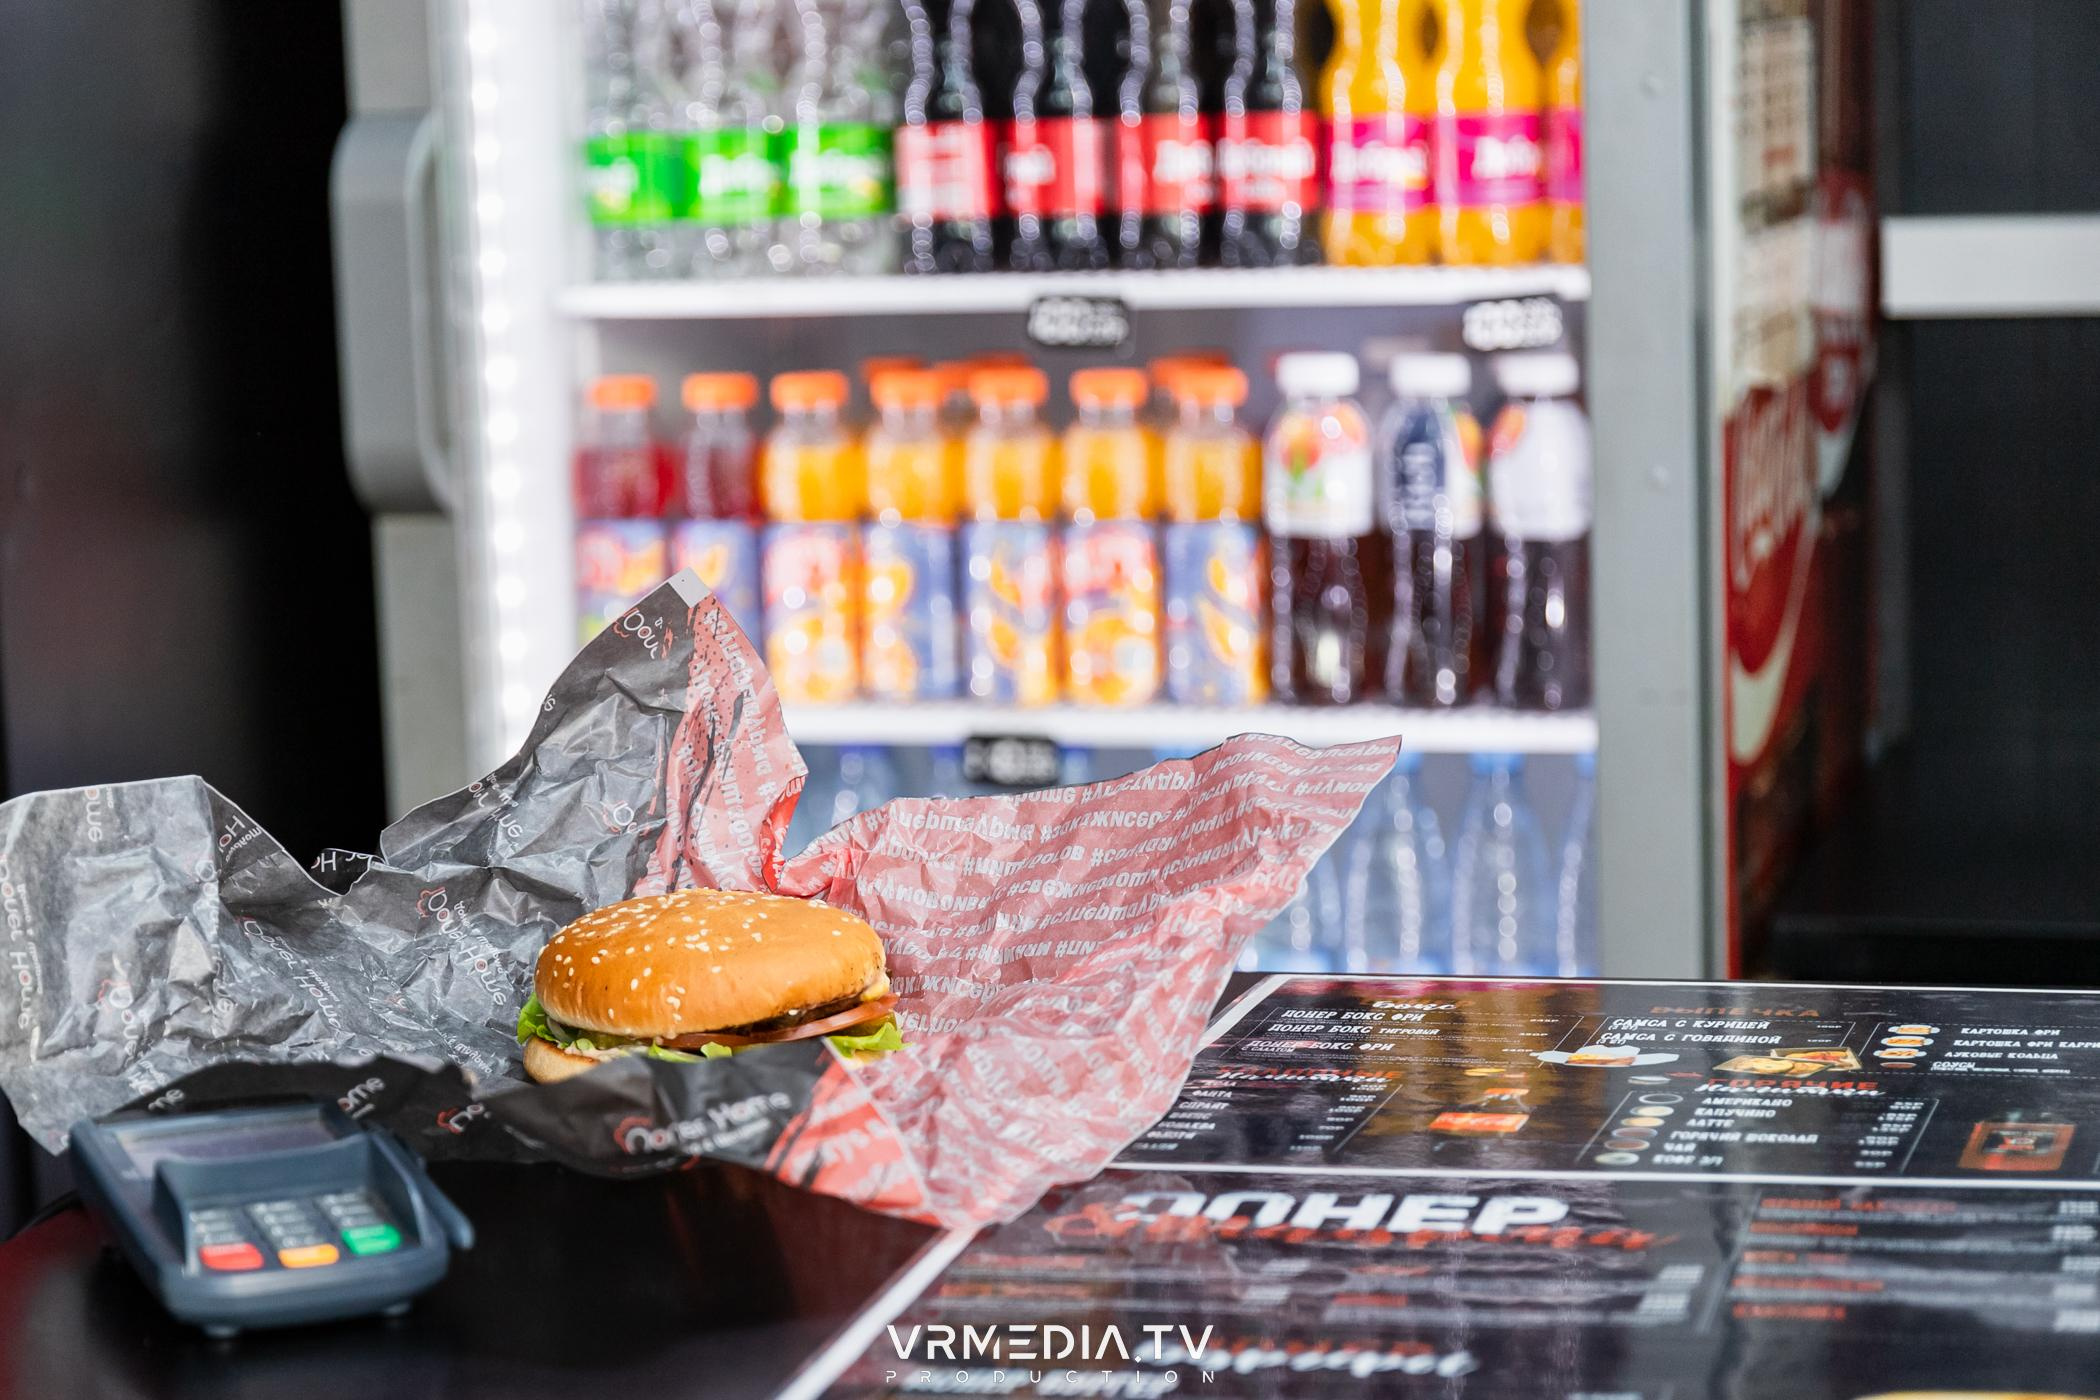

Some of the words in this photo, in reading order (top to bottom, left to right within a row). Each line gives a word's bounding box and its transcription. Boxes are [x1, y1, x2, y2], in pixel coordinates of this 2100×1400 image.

[1281, 1009, 1337, 1018] ДОНЕР
[1342, 1012, 1386, 1020] БОКС
[1391, 1013, 1426, 1021] ФРИ
[1267, 1023, 1324, 1032] ДОНЕР
[1328, 1025, 1373, 1034] БОКС
[1612, 1019, 1667, 1028] САМСА
[1675, 1020, 1687, 1028] С
[1693, 1020, 1770, 1030] КУРИЦЕЙ
[1600, 1033, 1656, 1042] САМСА
[1664, 1034, 1676, 1042] С
[1683, 1034, 1782, 1045] ГОВЯДИНОЙ
[1310, 1042, 1354, 1050] БОКС
[1359, 1043, 1395, 1051] ФРИ
[2008, 1052, 2058, 1060] КОЛЬЦА
[1192, 1090, 1233, 1098] ФАНТА
[1702, 1098, 1793, 1107] АМЕРИКАНО
[1695, 1107, 1777, 1117] КАПУЧИНО
[1686, 1119, 1735, 1128] ЛАТТЕ
